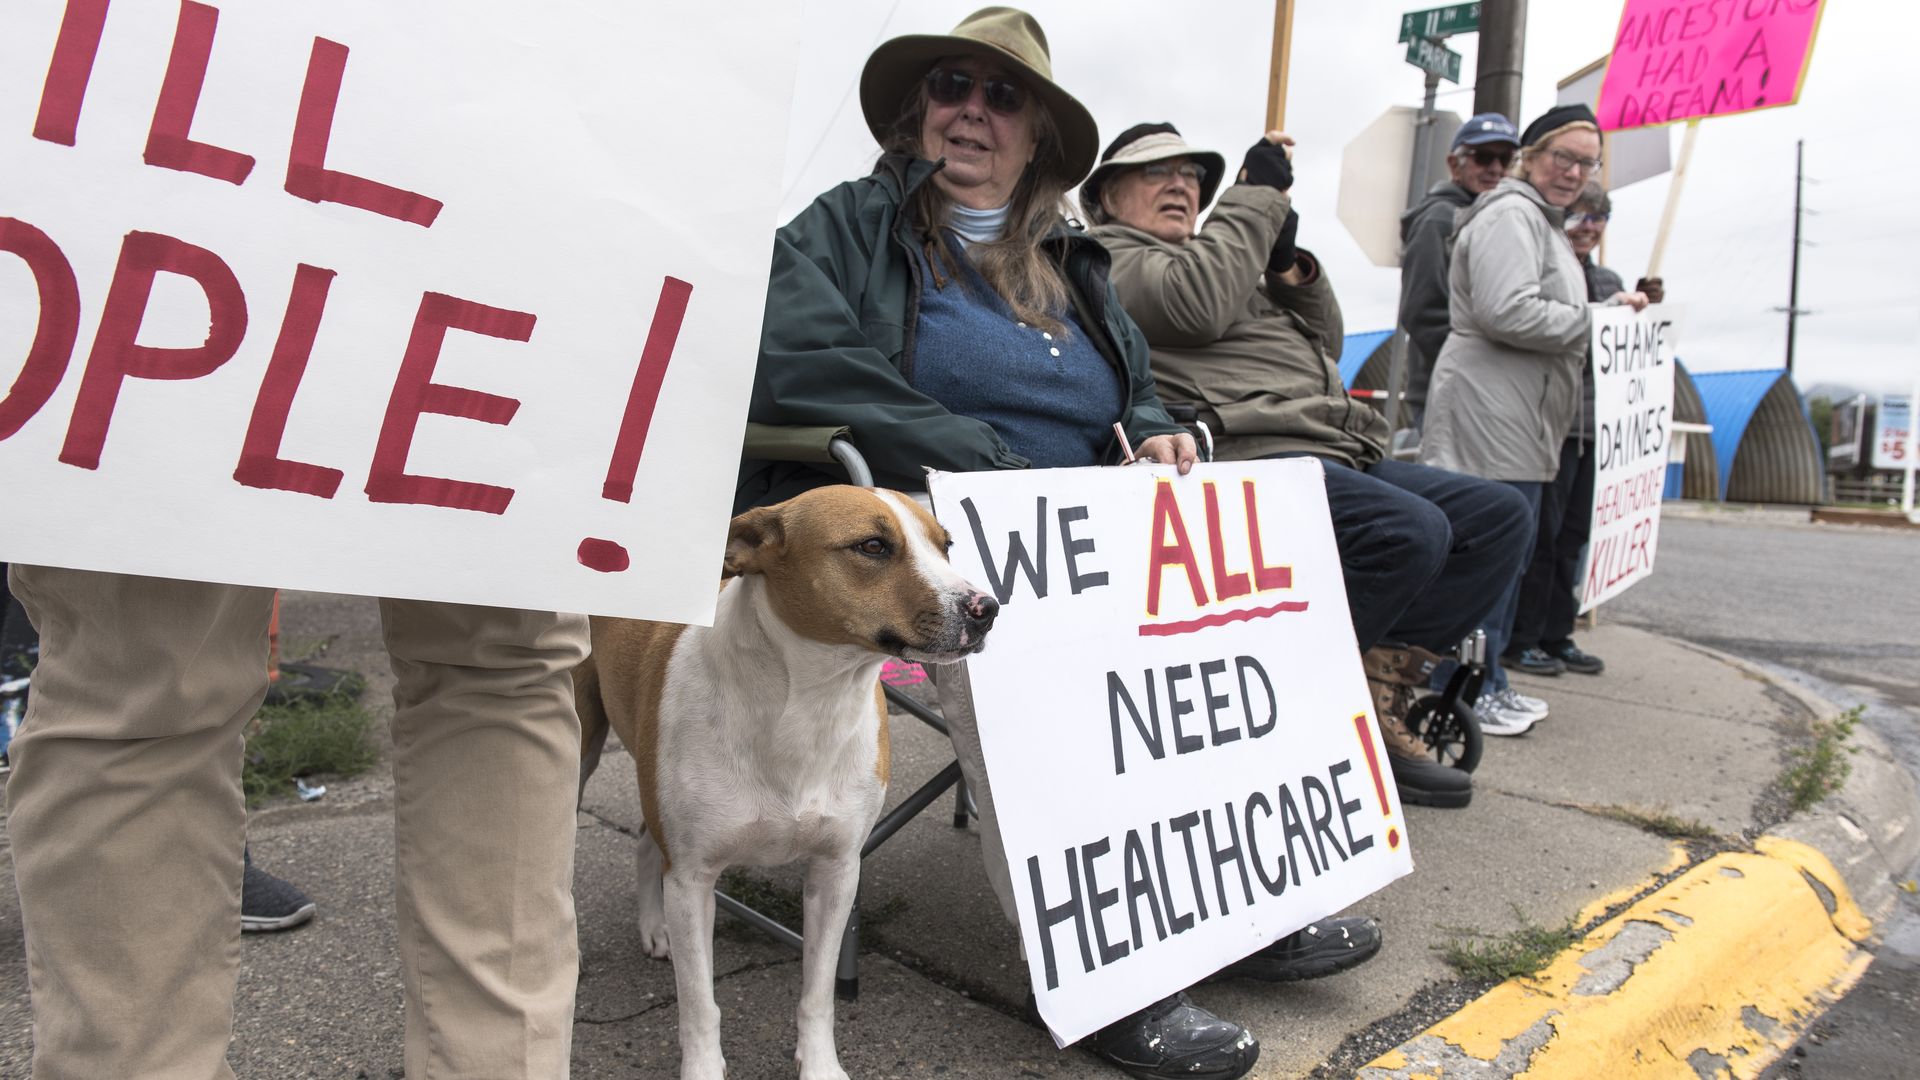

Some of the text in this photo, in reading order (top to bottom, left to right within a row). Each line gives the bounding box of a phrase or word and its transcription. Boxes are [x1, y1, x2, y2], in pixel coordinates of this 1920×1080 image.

[1637, 26, 1769, 88] HAD A
[1619, 66, 1770, 128] DREAM!
[1600, 320, 1671, 375] SHAME
[1627, 378, 1645, 405] ON
[1600, 406, 1667, 471] DAINES
[1593, 466, 1664, 530] HEALTHCARE
[960, 476, 1293, 616] WE ALL
[1584, 518, 1652, 604] KILLER
[1106, 655, 1277, 775] NEED
[1027, 712, 1400, 991] HEALTHCARE!
